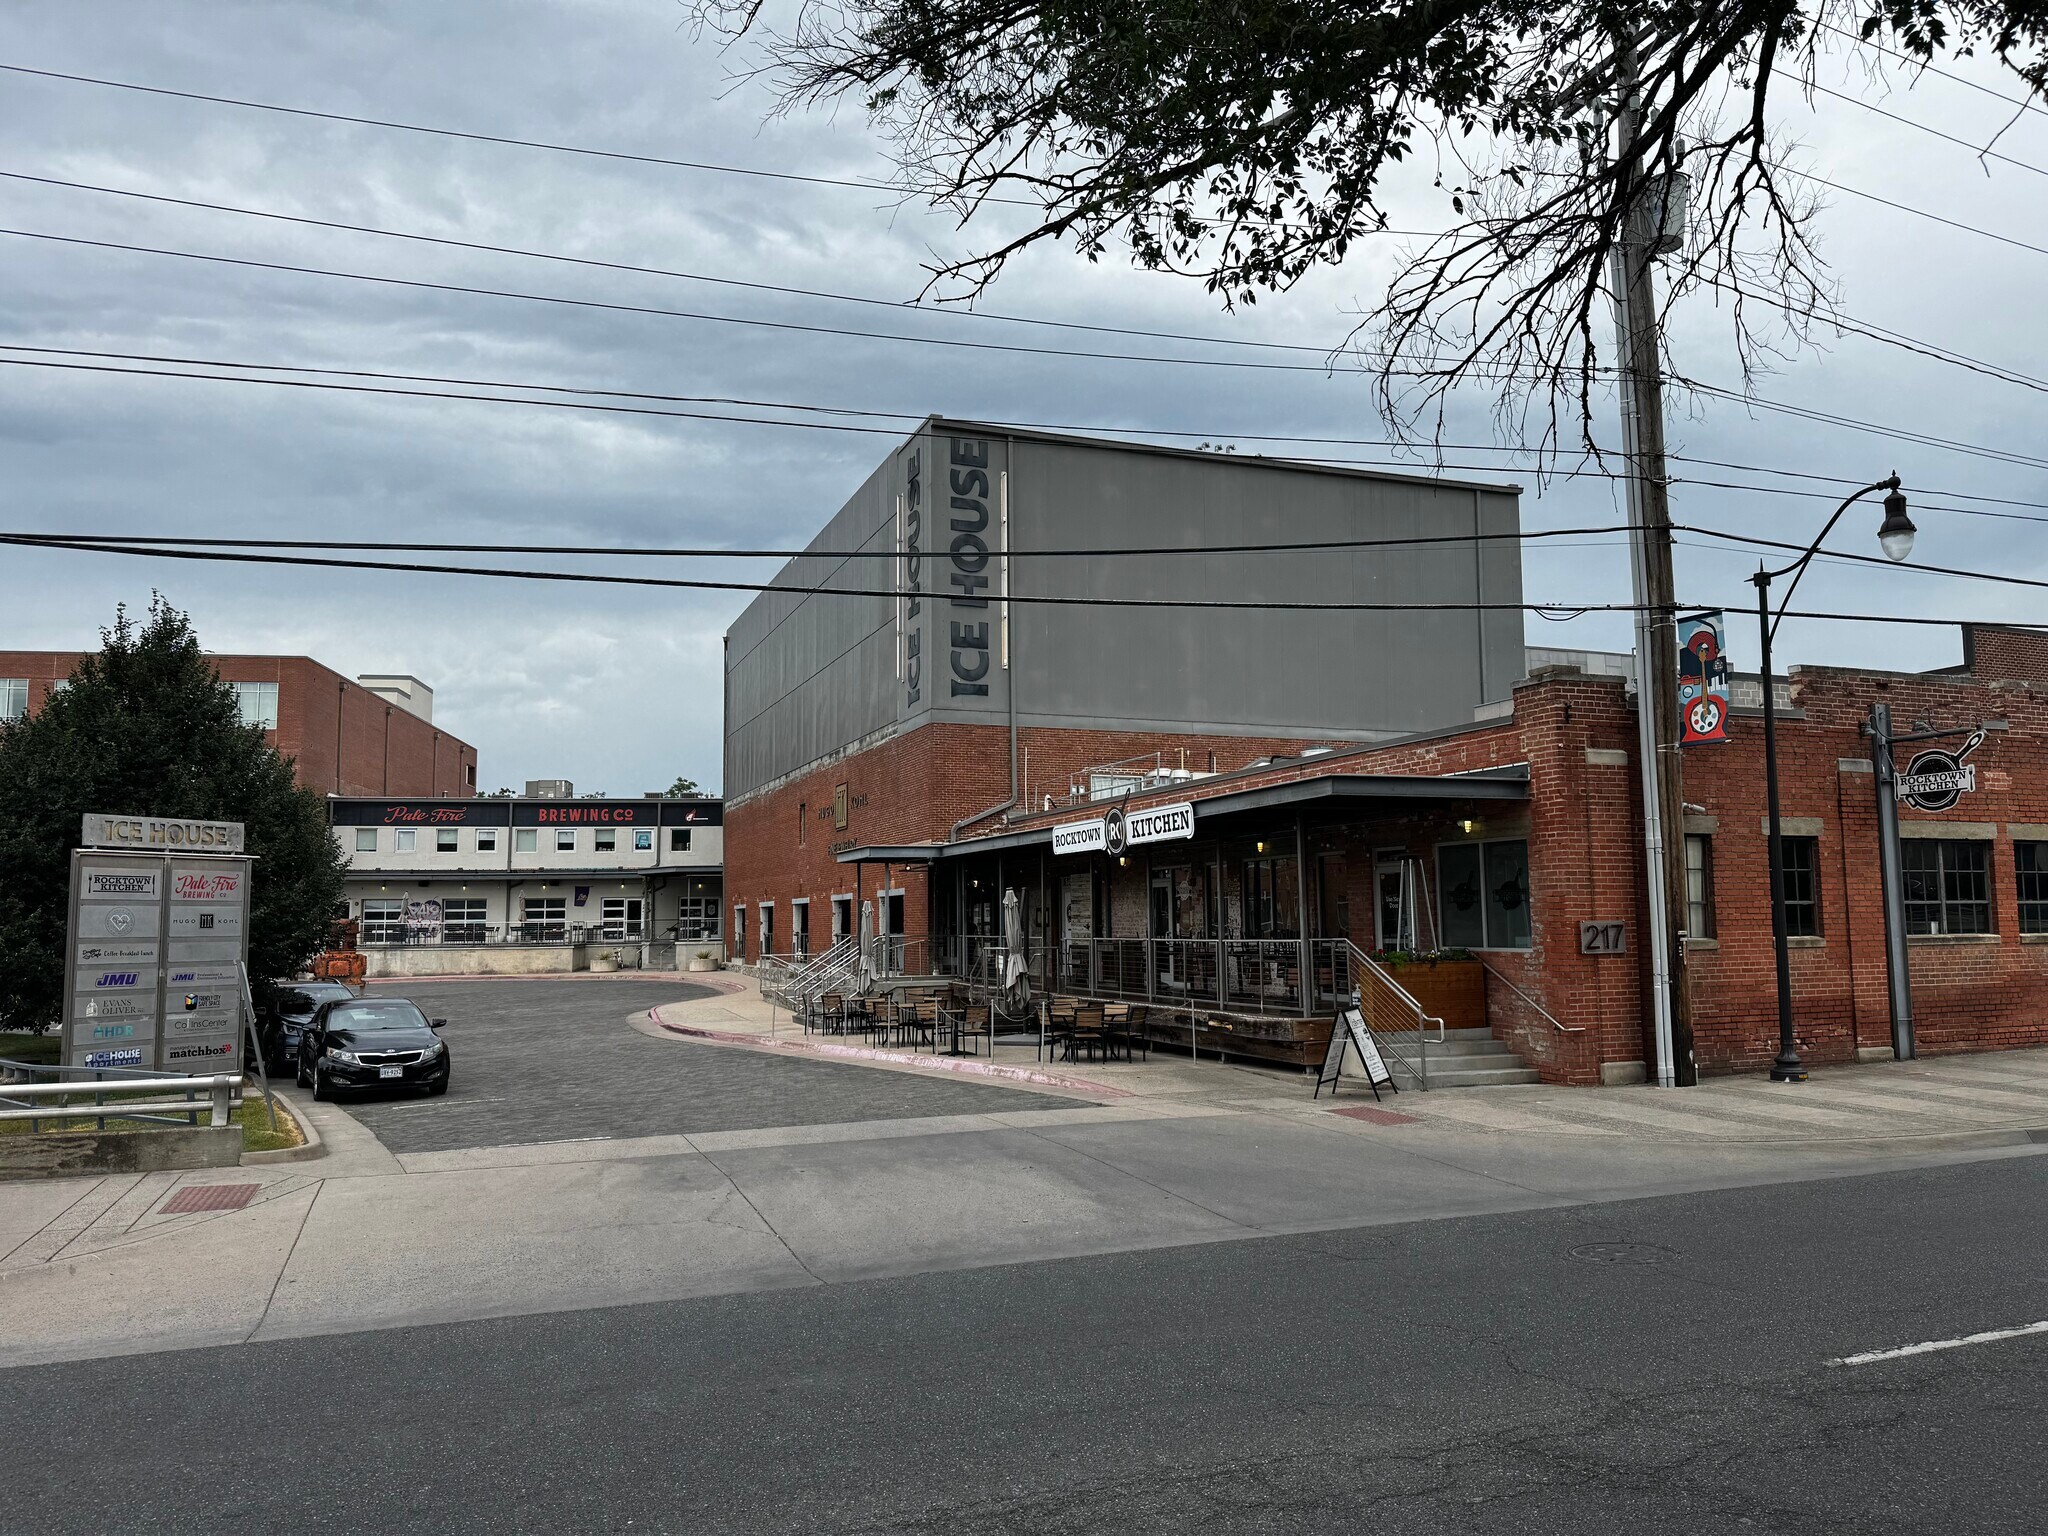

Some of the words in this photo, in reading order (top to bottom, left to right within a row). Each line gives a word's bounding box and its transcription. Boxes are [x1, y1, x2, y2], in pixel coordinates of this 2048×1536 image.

[950, 438, 990, 608] HOUSE
[907, 447, 921, 620] HOUSE
[950, 621, 990, 697] ICE
[907, 627, 921, 708] ICE
[1901, 771, 1966, 786] ROCKTOWN
[1908, 780, 1959, 793] KITCHEN
[384, 806, 429, 823] Pale
[430, 806, 467, 823] Fire
[538, 808, 609, 822] BREWING
[105, 820, 143, 842] ICE
[149, 823, 227, 846] HOUSE
[1055, 827, 1101, 848] ROCKTOWN
[1131, 810, 1190, 839] KITCHEN
[94, 875, 151, 886] ROCKTOWN
[100, 883, 144, 891] KITCHEN
[175, 874, 211, 894] Pale
[211, 873, 240, 894] Fire
[182, 891, 215, 899] BREWING
[1586, 925, 1624, 950] 217
[96, 973, 138, 986] JMU
[172, 973, 195, 982] JMU
[103, 999, 132, 1007] EVANS
[102, 1006, 137, 1015] OLIVER
[105, 1025, 134, 1037] HDR
[169, 1046, 227, 1058] matchbox
[86, 1058, 141, 1068] Apartments
